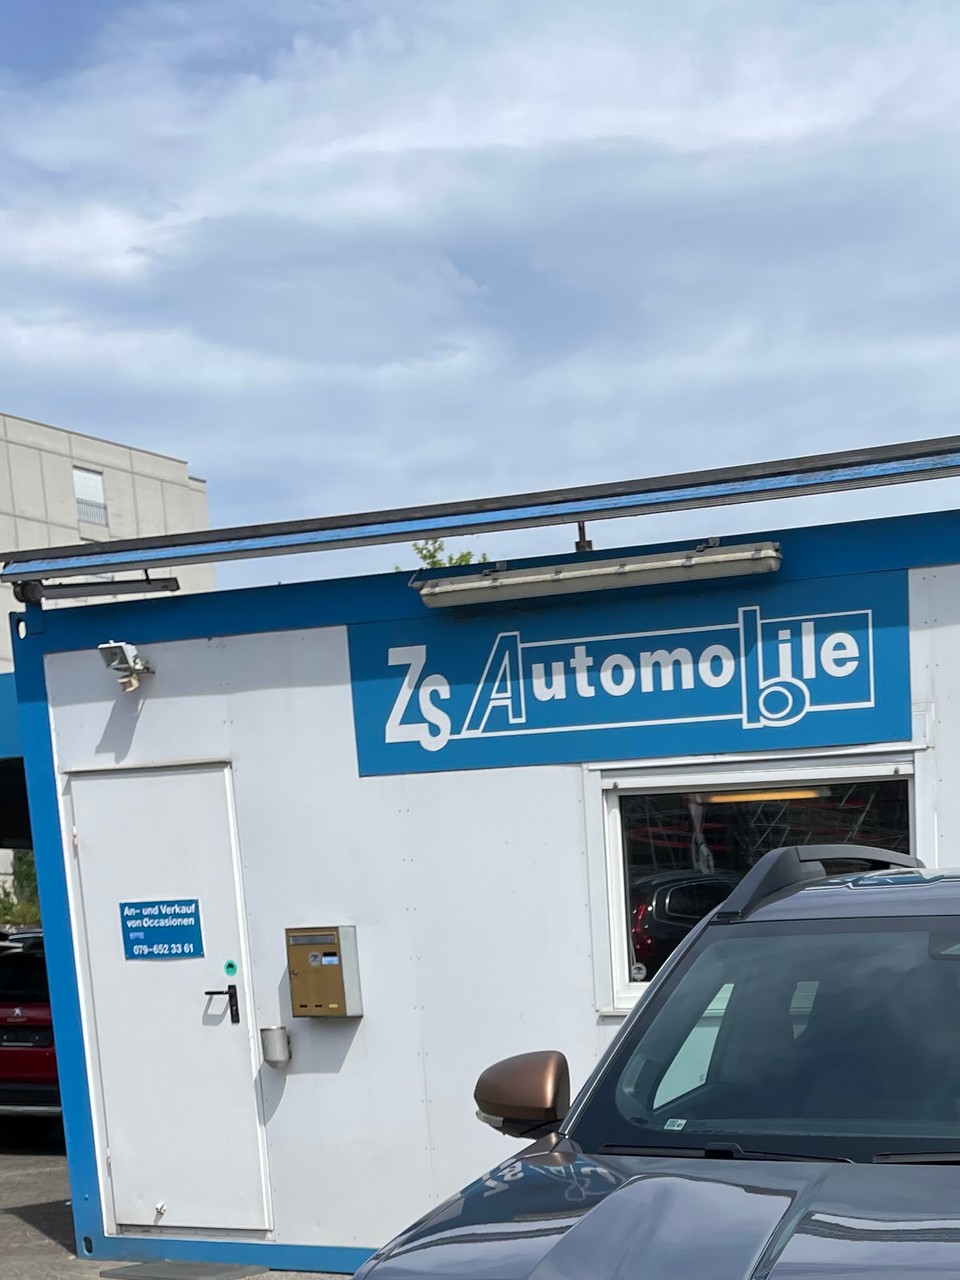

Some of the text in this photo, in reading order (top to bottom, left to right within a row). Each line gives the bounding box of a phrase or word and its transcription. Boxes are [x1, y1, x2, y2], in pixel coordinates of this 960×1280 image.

[461, 606, 860, 736] Automobile
[124, 903, 196, 916] An- und Verkauf
[126, 916, 195, 928] von Occasionen
[171, 943, 182, 954] 33
[183, 943, 194, 953] 61
